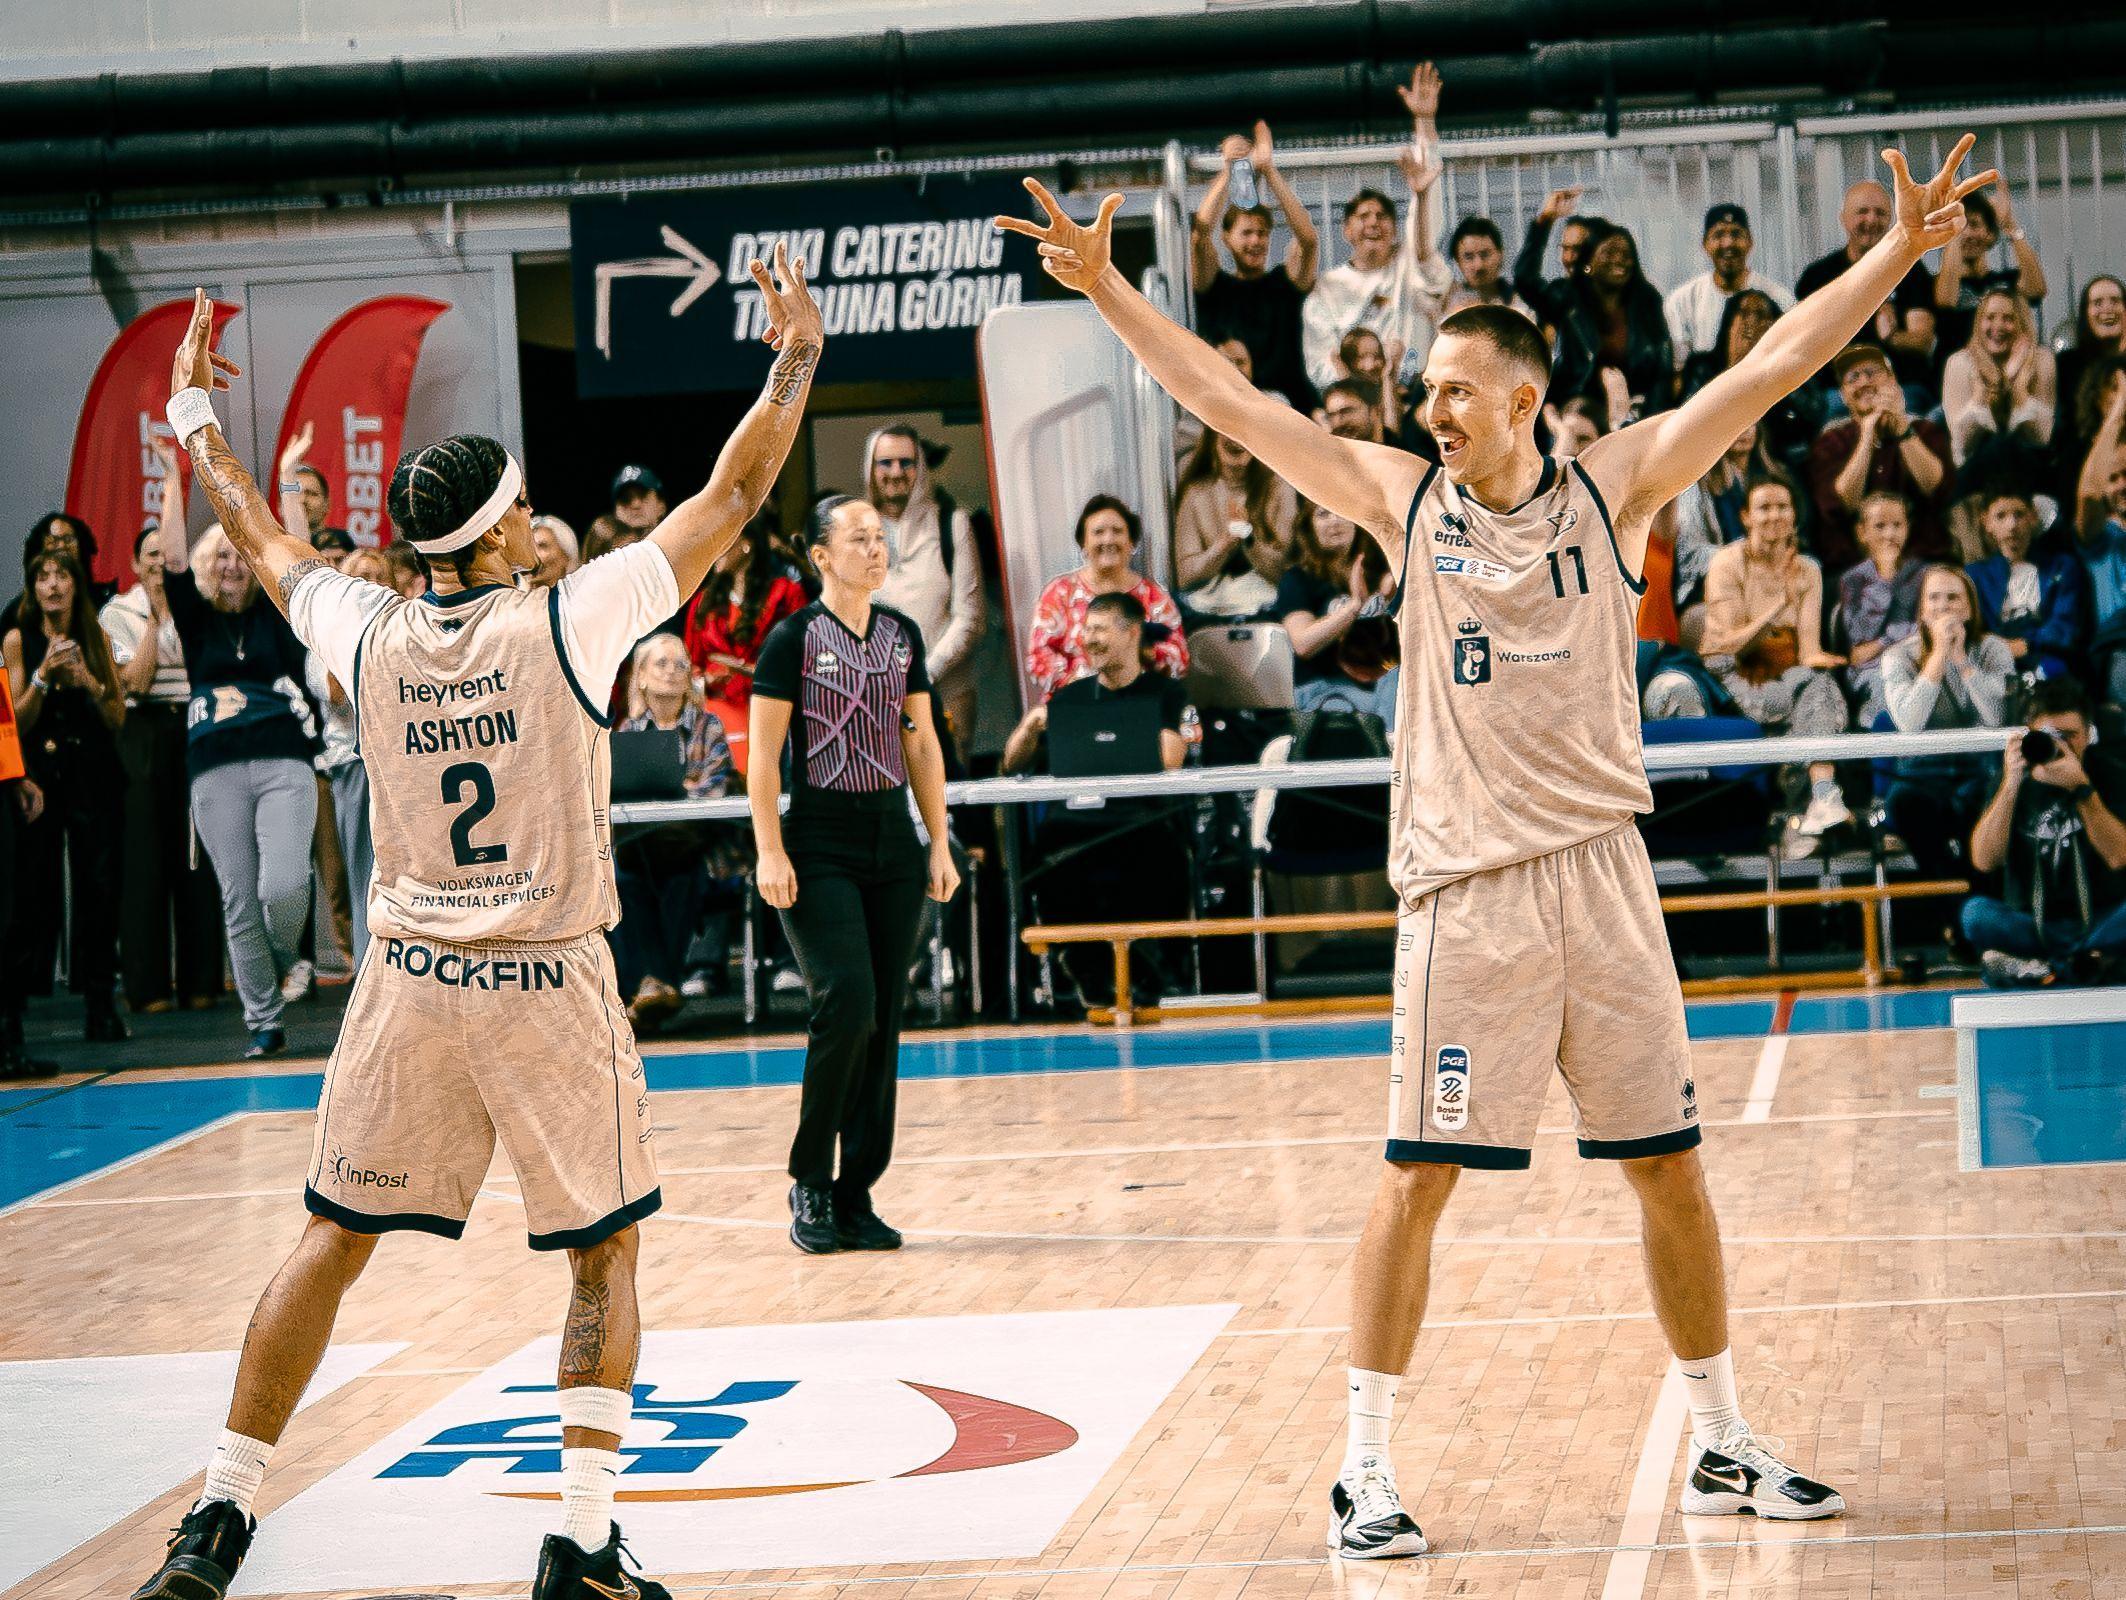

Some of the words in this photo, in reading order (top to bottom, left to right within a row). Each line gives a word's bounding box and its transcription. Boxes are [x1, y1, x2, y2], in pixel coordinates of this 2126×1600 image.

[831, 218, 1004, 277] CATERING
[1546, 546, 1590, 598] 11
[1497, 650, 1571, 663] Warszawa
[398, 668, 507, 707] heyrent
[405, 708, 518, 755] ASHTON
[441, 761, 508, 868] 2
[411, 895, 488, 908] FINANCIAL
[493, 884, 556, 907] SERVICES
[437, 870, 533, 892] VOLKSWAGEN
[386, 939, 564, 991] ROCKFIN
[1441, 1056, 1466, 1066] PGE
[346, 1163, 409, 1188] InPost
